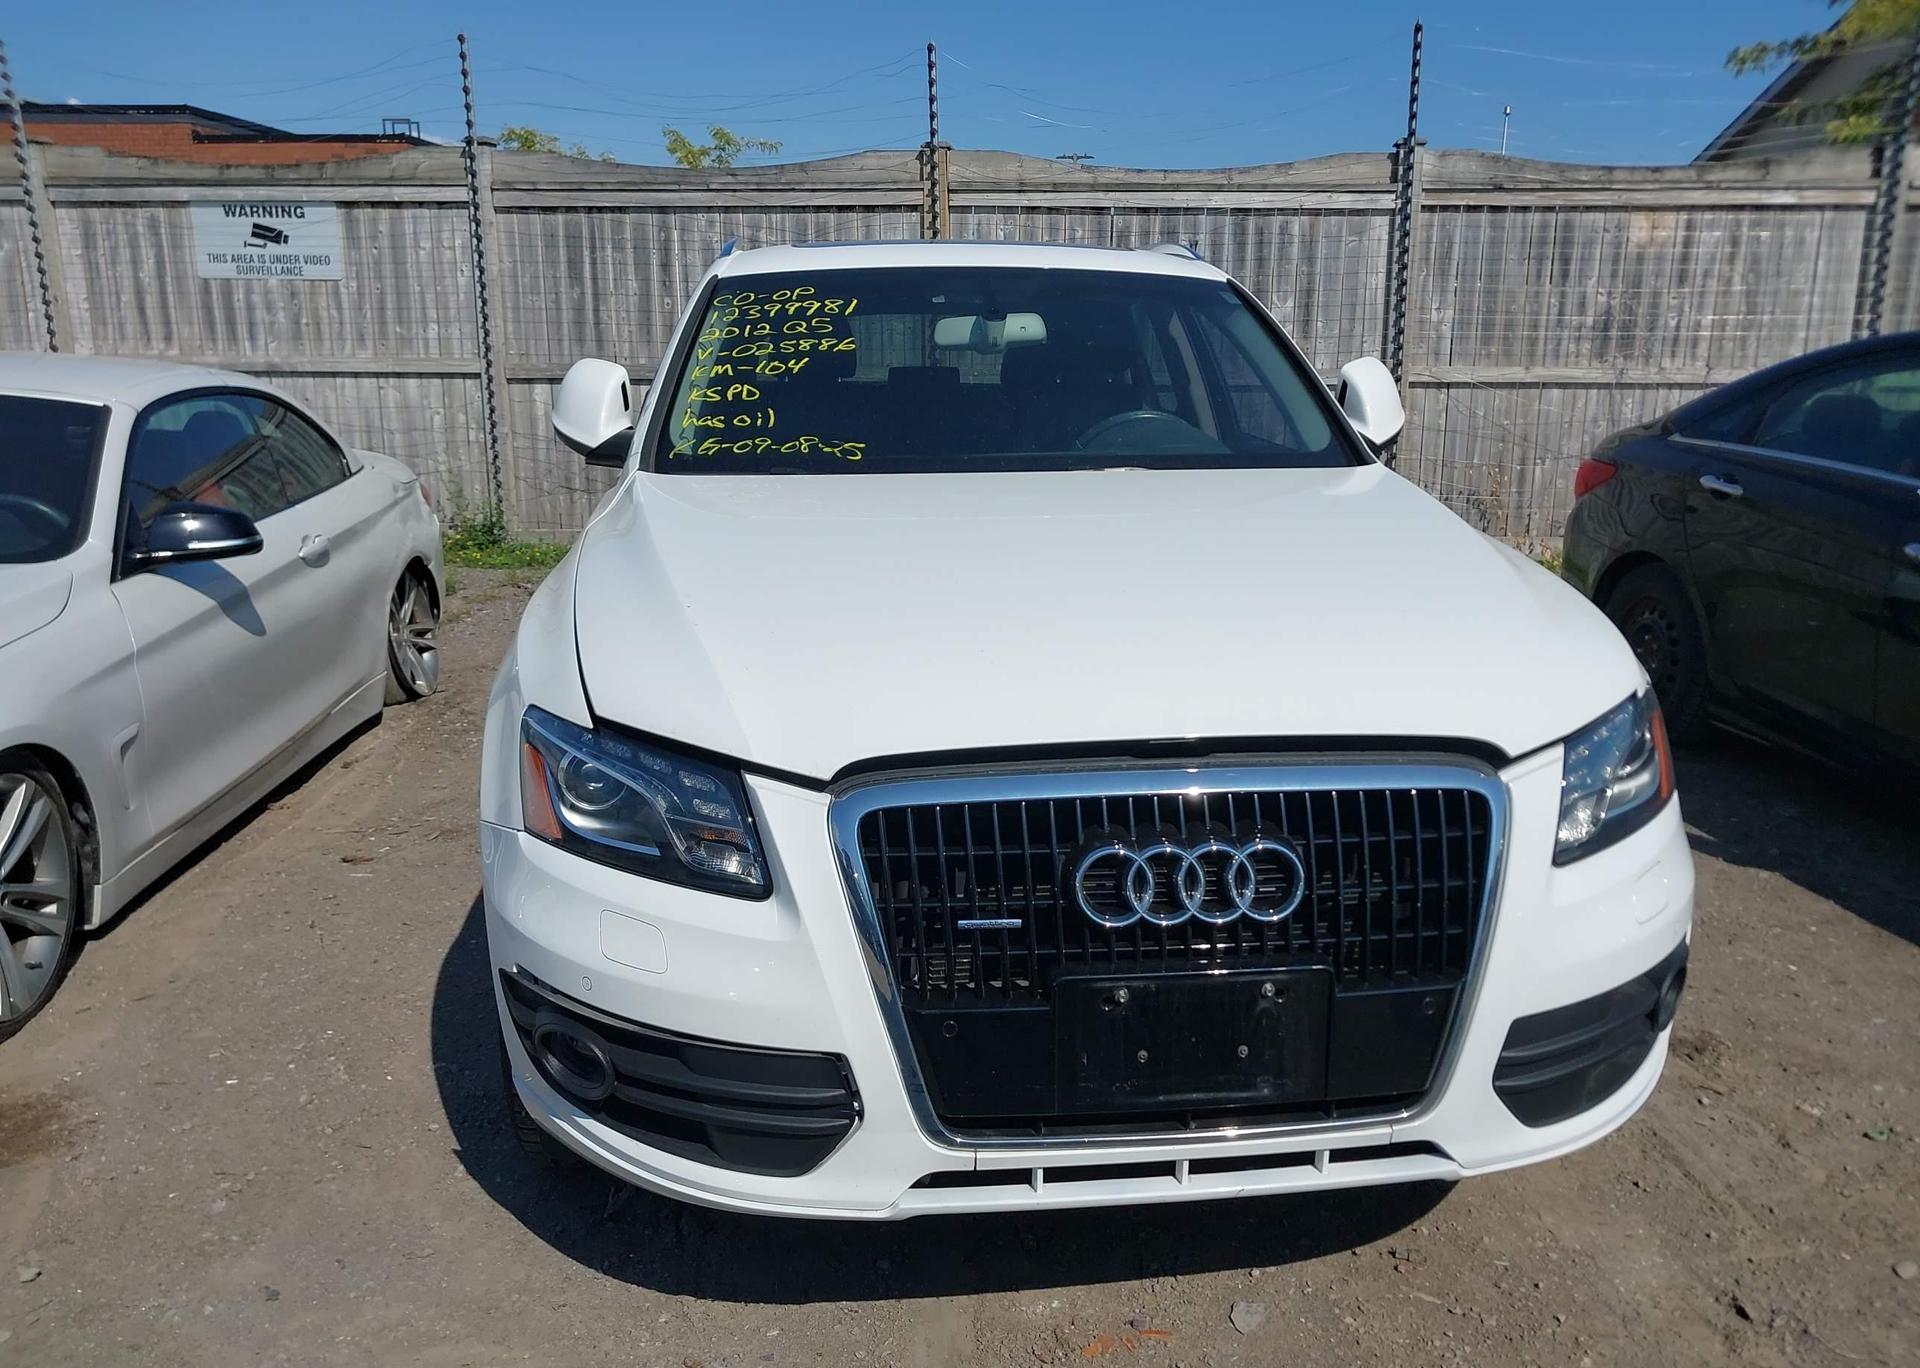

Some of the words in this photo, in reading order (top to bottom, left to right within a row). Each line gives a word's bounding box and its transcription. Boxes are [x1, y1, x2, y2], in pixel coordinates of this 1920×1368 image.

[222, 204, 306, 219] WARNING
[207, 253, 228, 264] THIS
[231, 253, 255, 265] AREA
[257, 254, 266, 265] IS
[269, 254, 301, 266] UNDER
[303, 255, 331, 266] VIDEO
[236, 265, 304, 277] SURVEILLANCE
[699, 323, 777, 342] 2012
[783, 318, 833, 334] Q5
[682, 408, 725, 429] has
[733, 407, 776, 429] oil
